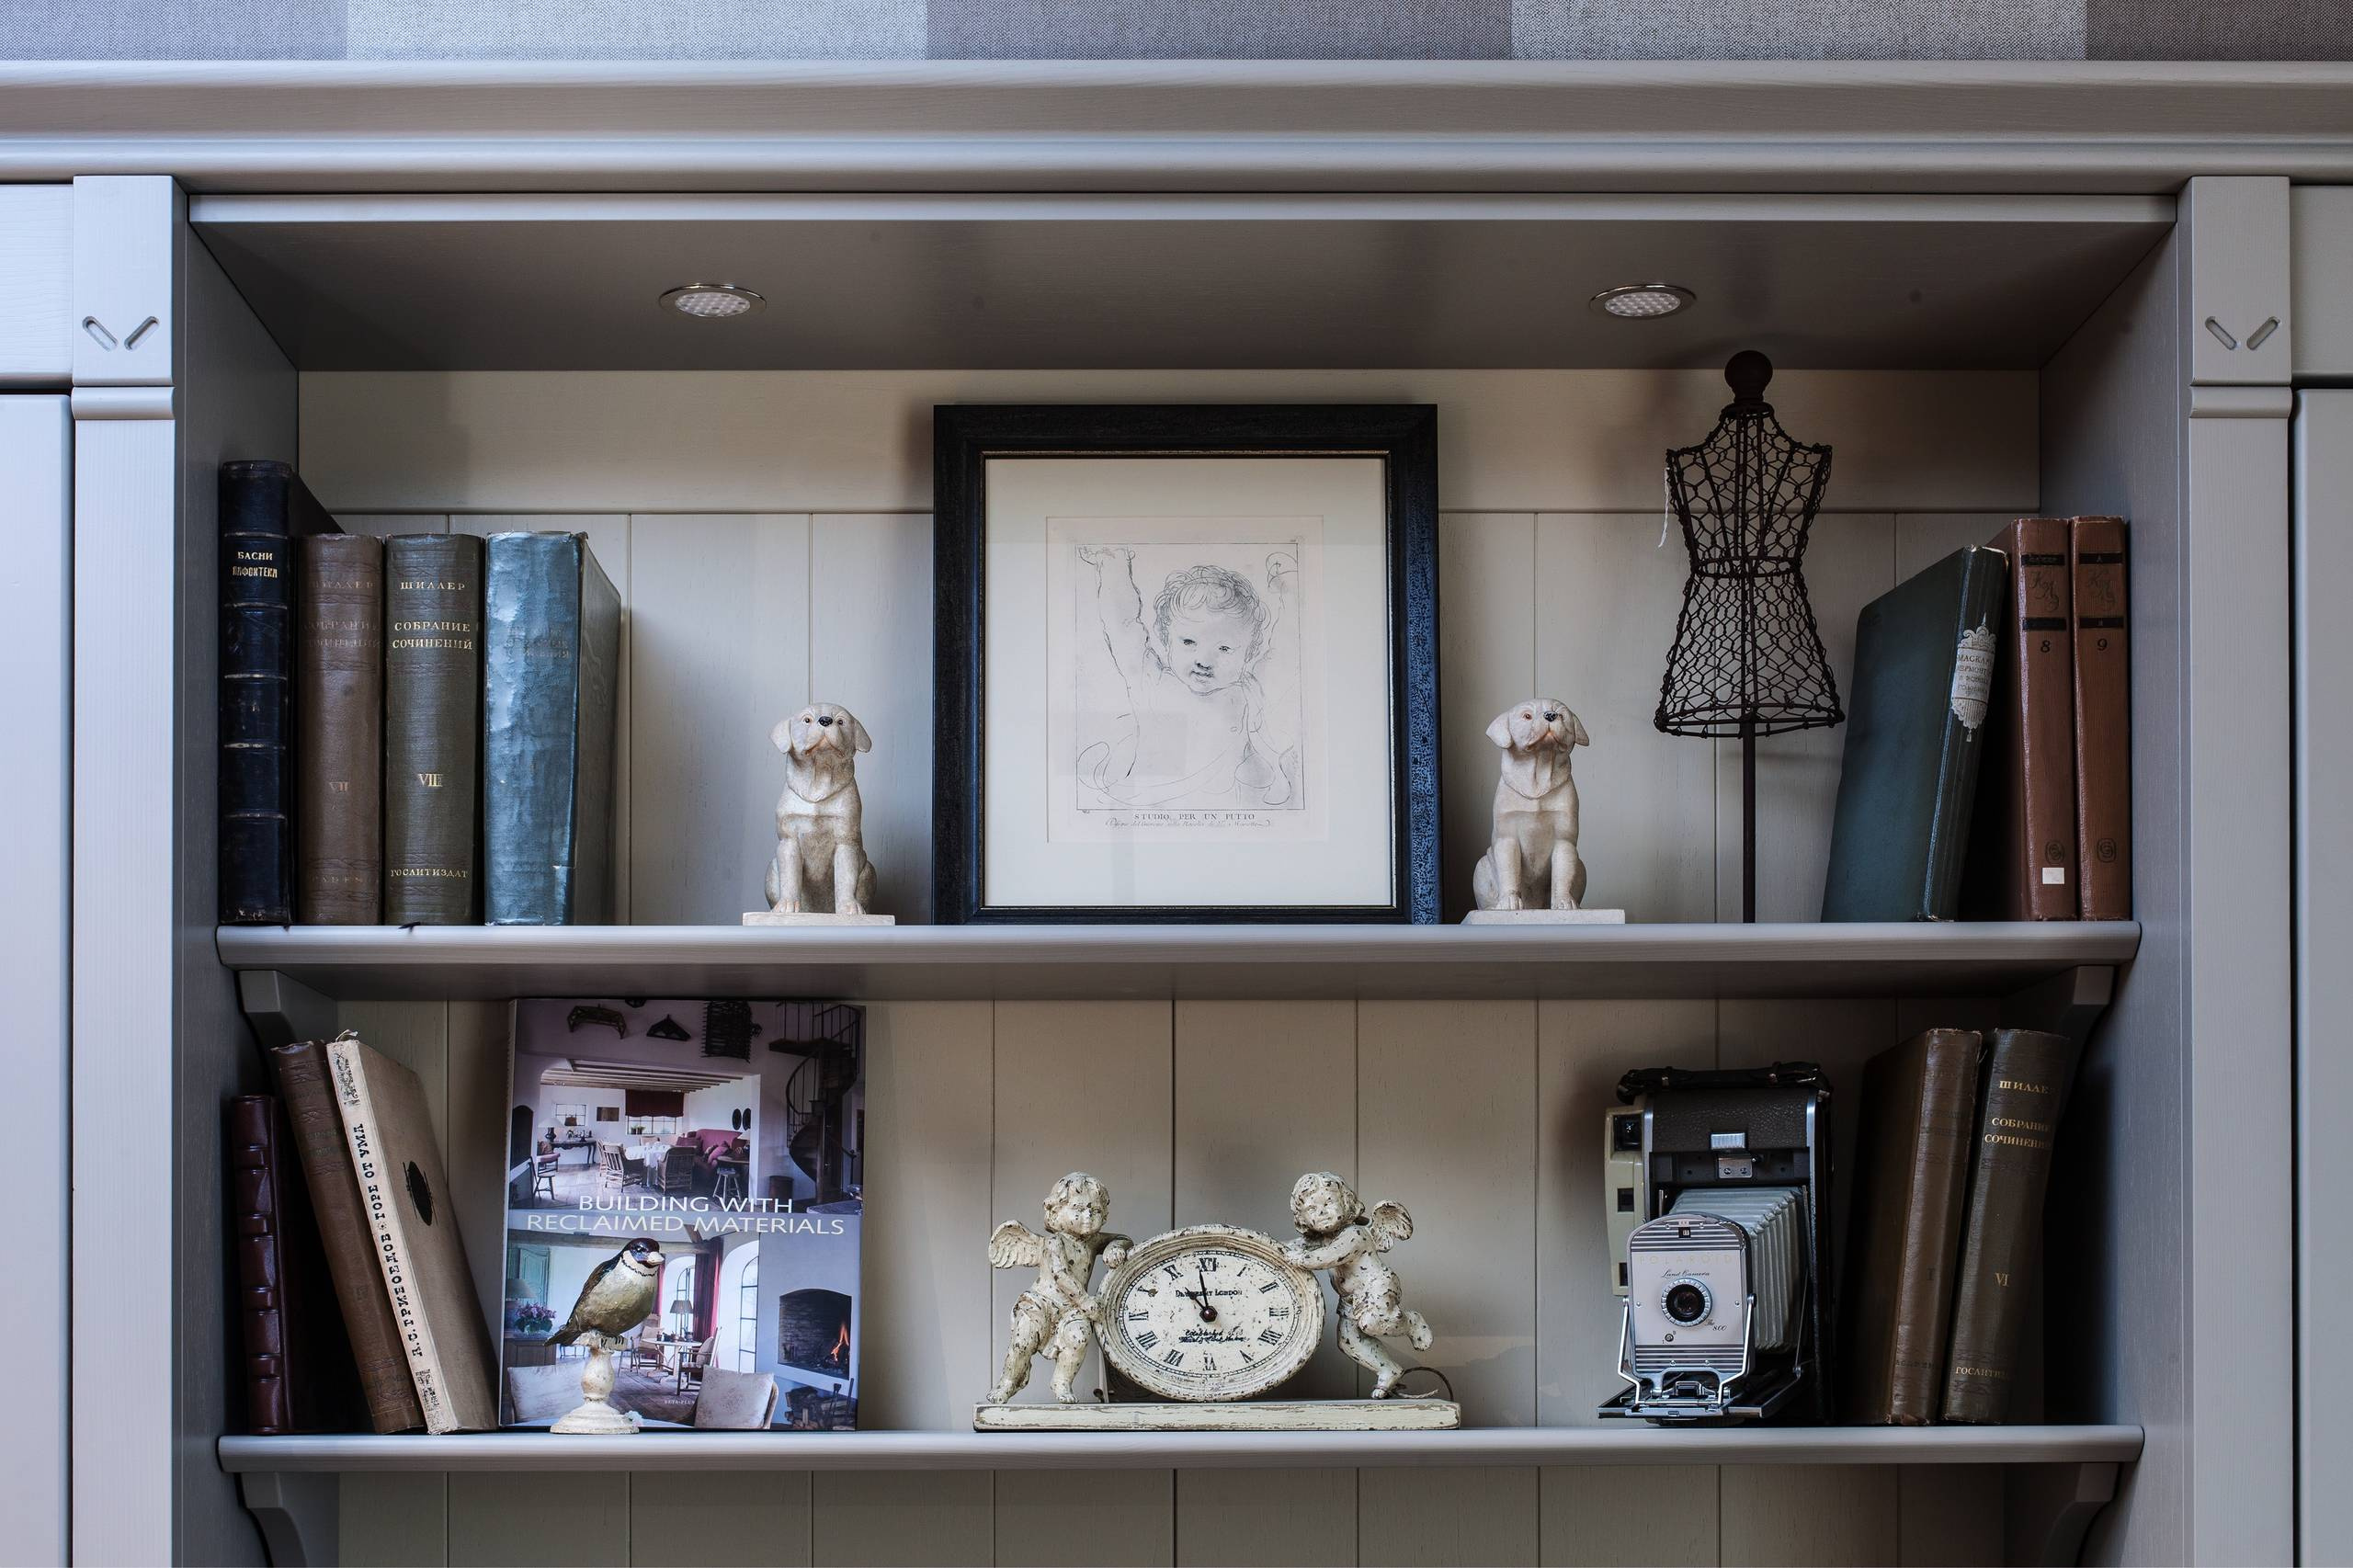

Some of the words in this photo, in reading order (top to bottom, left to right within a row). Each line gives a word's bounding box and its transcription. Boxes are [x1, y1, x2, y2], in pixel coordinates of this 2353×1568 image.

[238, 551, 273, 561] БАСНИ
[400, 582, 465, 590] ШИЛЛЕР
[394, 621, 471, 632] СОБРАНИЕ
[392, 638, 472, 650] СОЧИНЕНИЙ
[2040, 640, 2051, 653] 8
[2097, 638, 2108, 652] 9
[390, 868, 468, 879] ГОСЛИТИЗДАТ
[1999, 1080, 2050, 1094] ШИЛЛЕ
[353, 1123, 369, 1158] УМА
[1984, 1134, 2051, 1148] СОЧИНЕНИ
[362, 1162, 375, 1179] ОТ
[368, 1184, 385, 1221] ГОРЕ
[578, 1196, 709, 1212] BUILDING
[721, 1197, 793, 1213] WITH
[527, 1214, 684, 1232] RECLAIMED
[693, 1216, 845, 1235] MATERIALS
[1640, 1253, 1733, 1266] POLAROID
[1662, 1269, 1681, 1278] Land
[1995, 1272, 2009, 1286] VI
[1259, 1281, 1279, 1294] II
[1269, 1307, 1289, 1317] III
